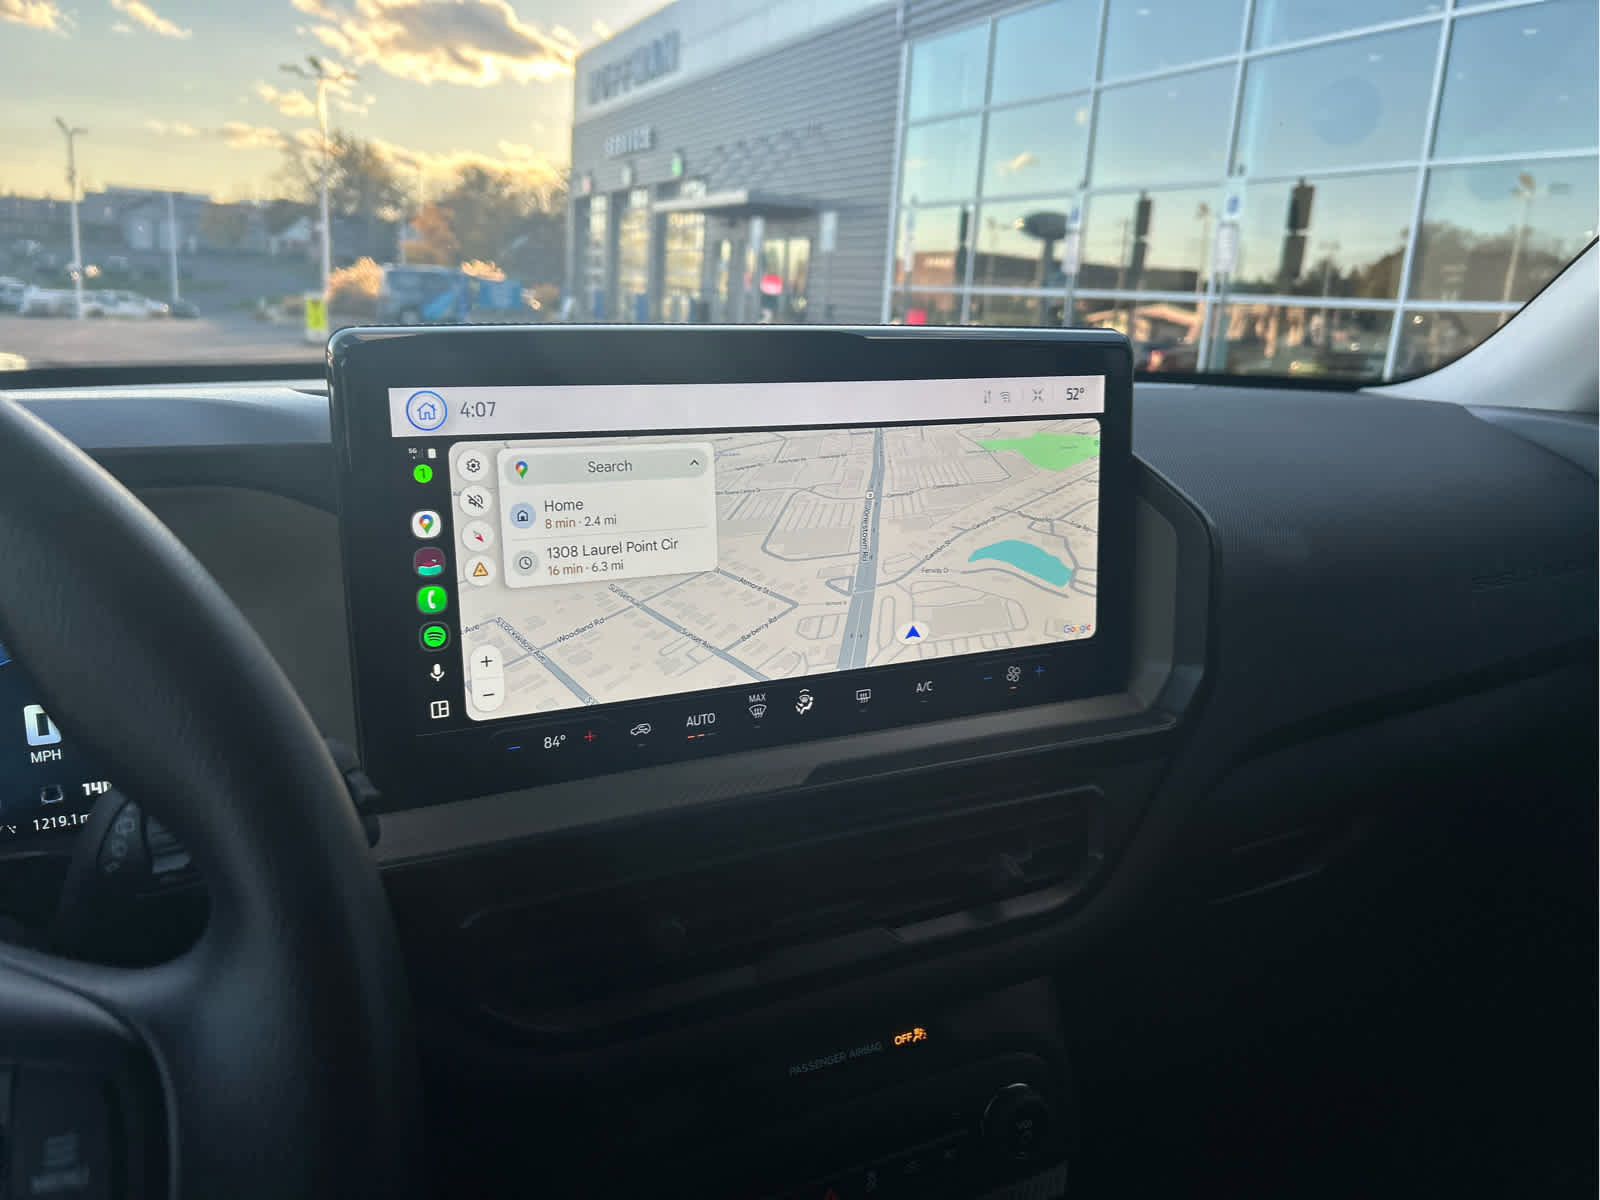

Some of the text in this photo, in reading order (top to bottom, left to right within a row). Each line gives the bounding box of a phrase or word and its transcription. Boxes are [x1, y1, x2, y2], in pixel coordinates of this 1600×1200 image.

[1066, 387, 1085, 401] 52°
[460, 401, 496, 418] 4:07
[588, 460, 633, 473] Search
[544, 500, 584, 512] Home
[545, 514, 617, 529] 8 min 2.4 mi
[546, 538, 679, 559] 1308 Laurel Point Cir
[548, 560, 624, 576] 16 min 6.3 mi
[557, 618, 604, 643] Woodland Rd
[1064, 624, 1091, 634] Google
[916, 681, 933, 693] A/C
[749, 693, 766, 703] MAX
[686, 713, 716, 727] AUTO
[544, 735, 566, 749] 84°
[30, 749, 62, 764] MPH
[33, 813, 77, 831] 1219.1
[894, 1032, 912, 1045] OFF
